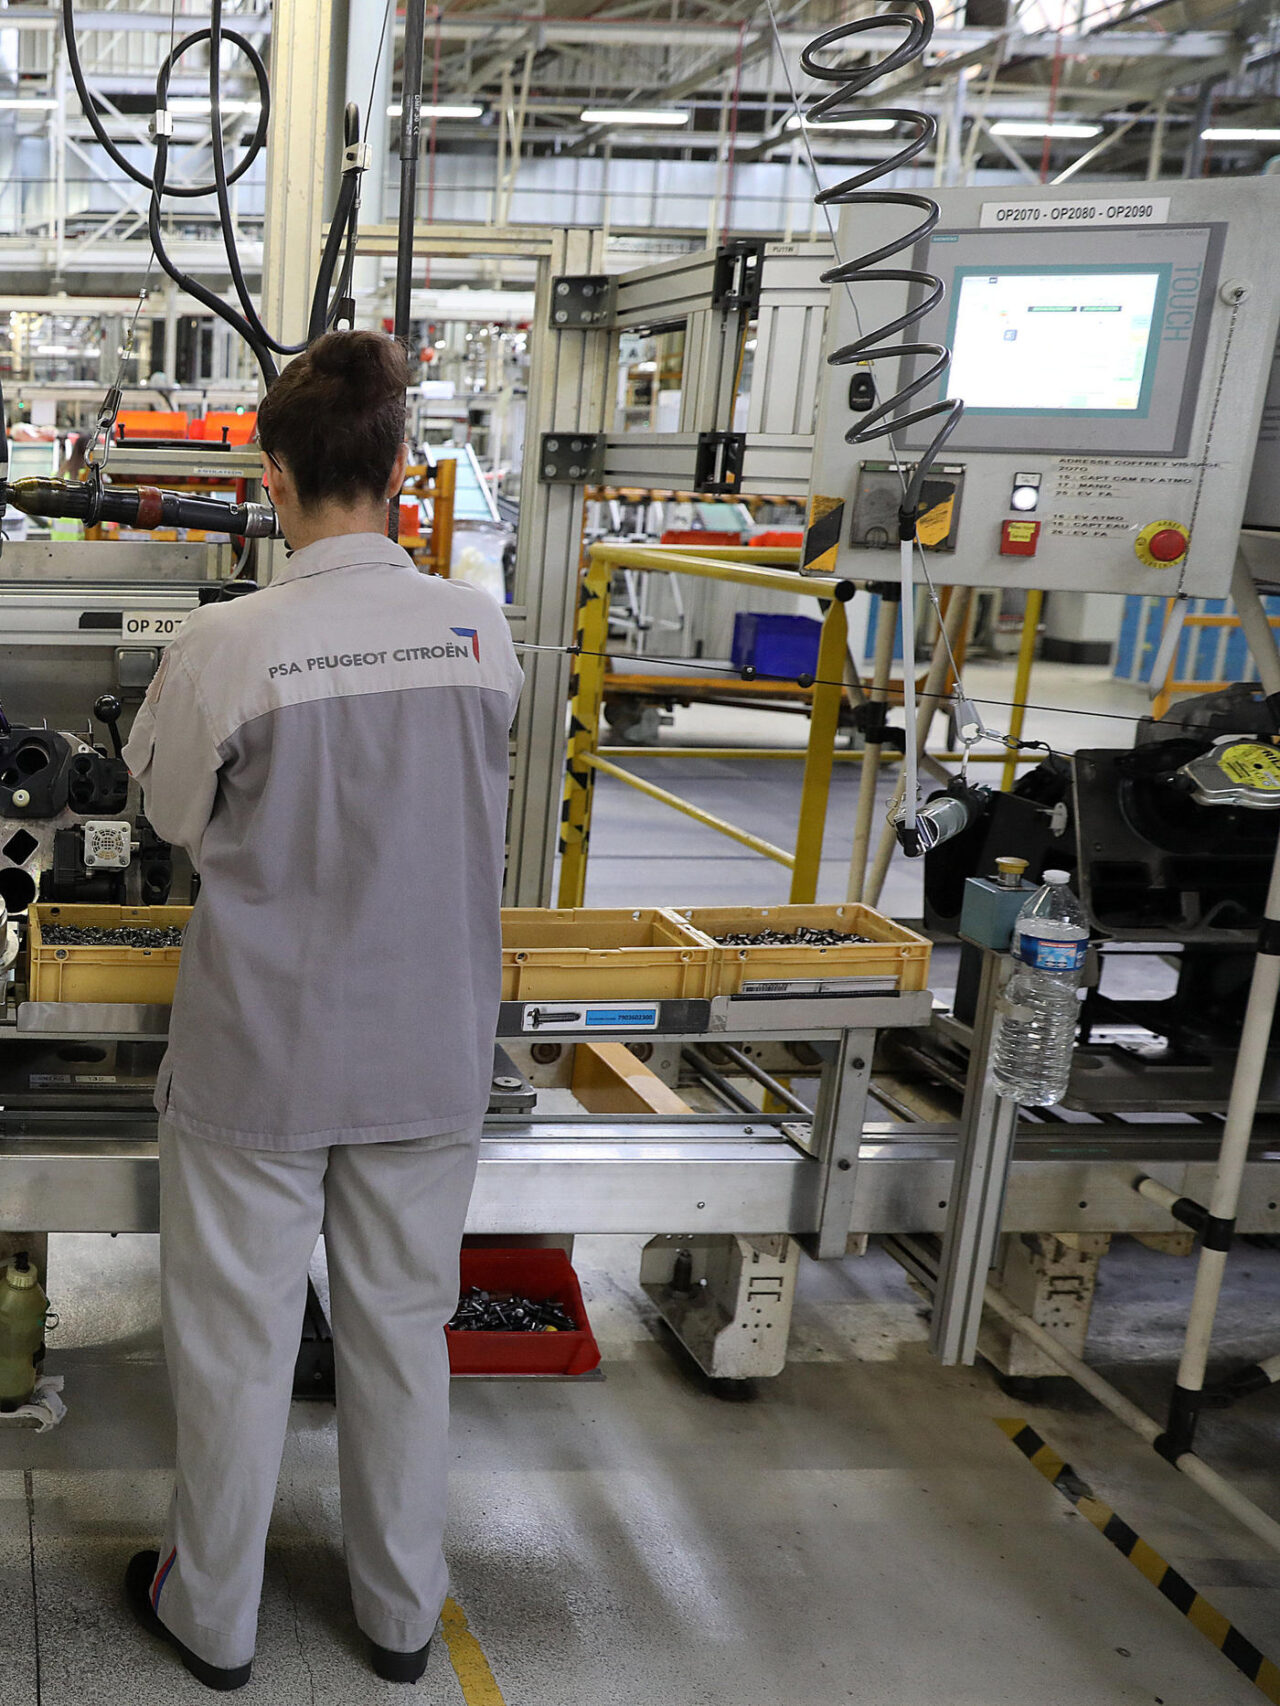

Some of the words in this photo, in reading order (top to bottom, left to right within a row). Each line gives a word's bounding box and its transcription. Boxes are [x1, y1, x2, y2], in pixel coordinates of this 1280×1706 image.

[996, 208, 1040, 222] OP2070
[1050, 206, 1096, 220] OP2080
[1106, 205, 1153, 219] OP2090
[1164, 267, 1202, 341] TOUCH
[127, 619, 150, 633] OP
[268, 662, 303, 679] PSA
[306, 651, 388, 671] PEUGEOT
[392, 643, 469, 662] CITROËN
